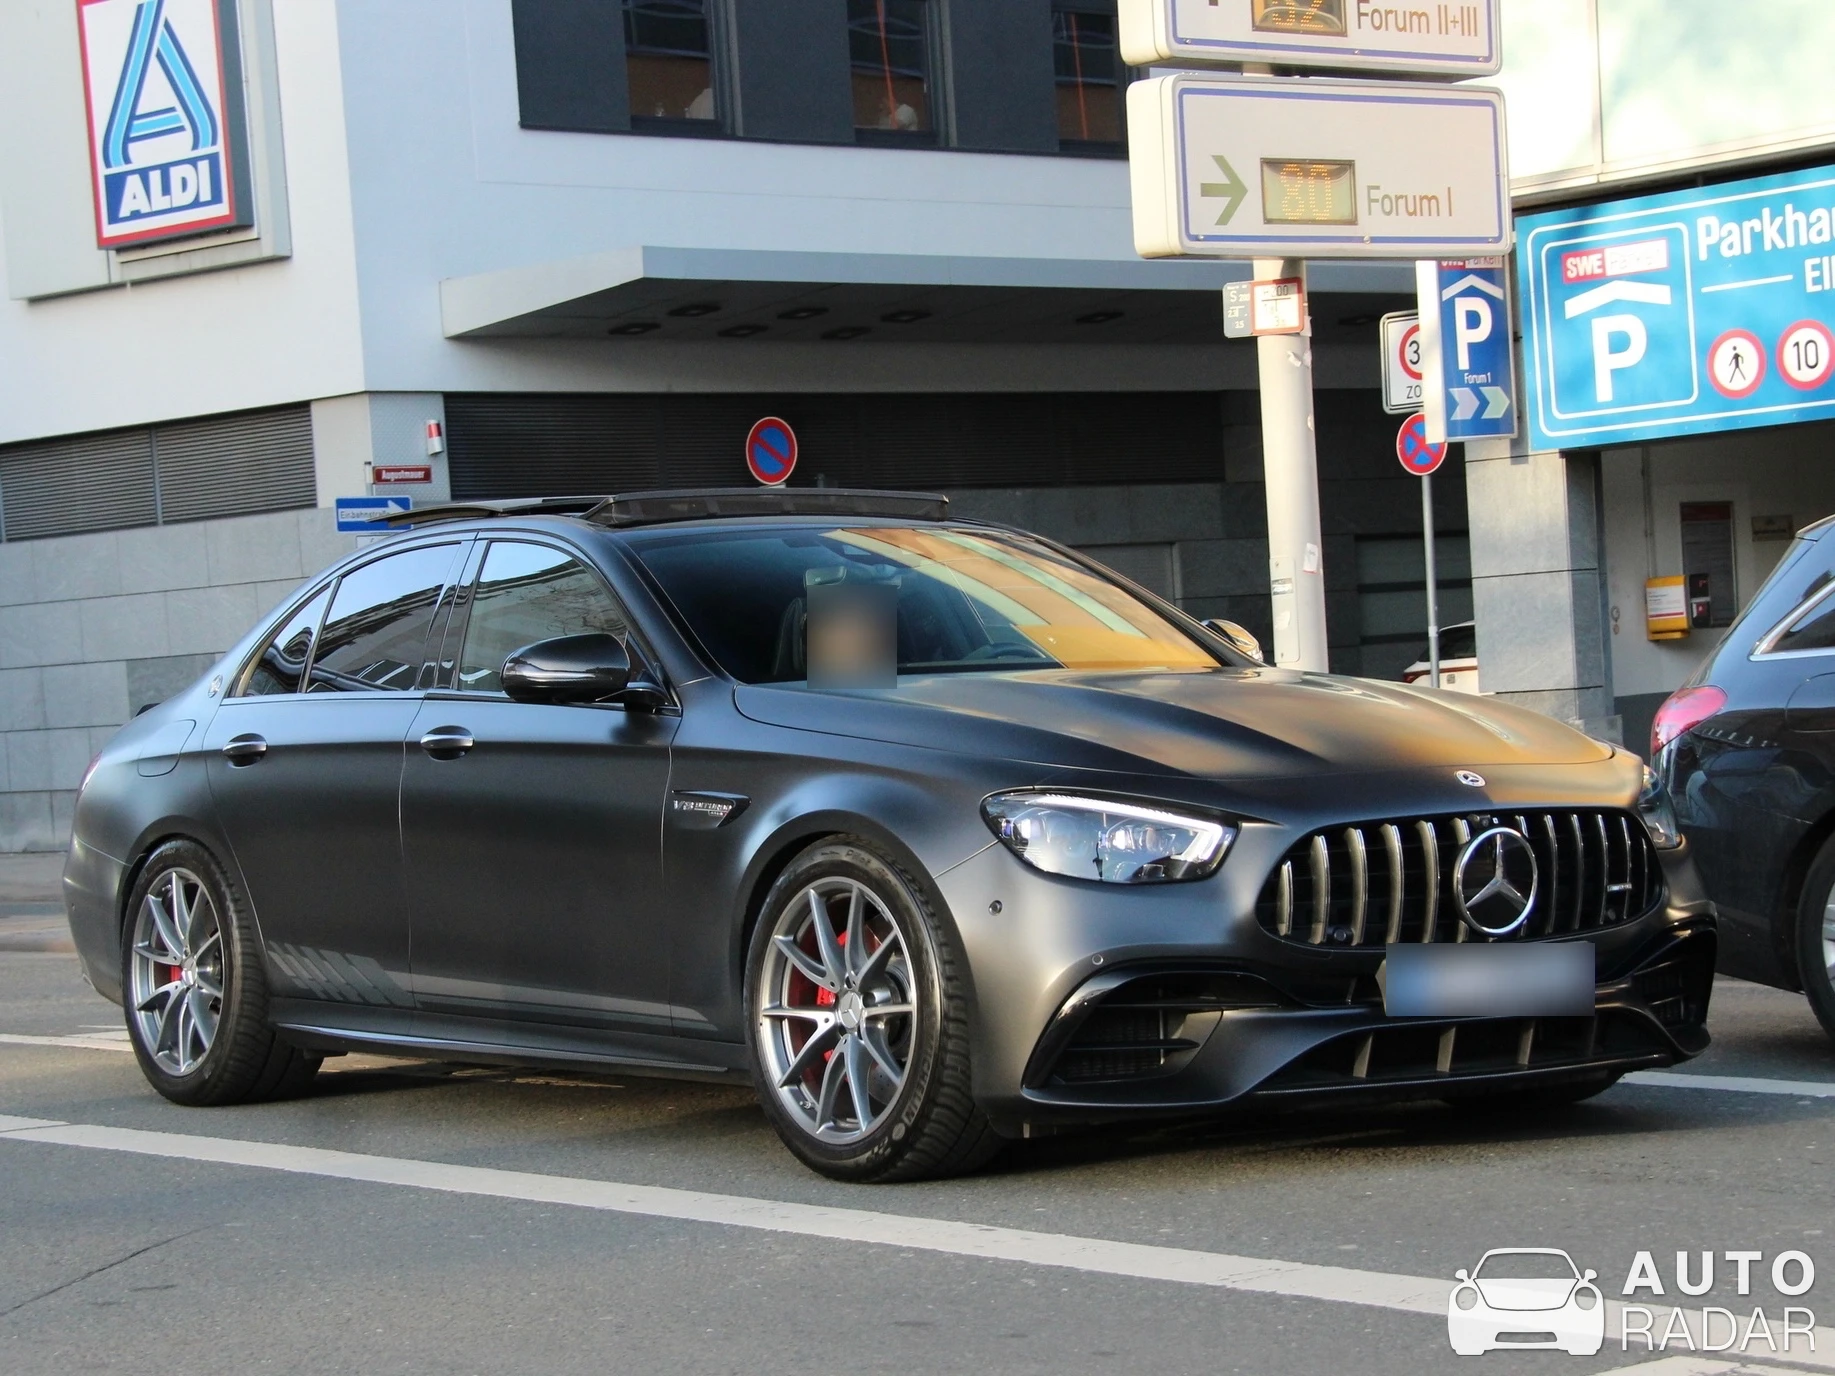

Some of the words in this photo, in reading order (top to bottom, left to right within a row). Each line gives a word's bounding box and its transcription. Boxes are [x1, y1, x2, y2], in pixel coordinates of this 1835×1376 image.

[1356, 0, 1430, 34] Forum
[118, 159, 213, 219] ALDI
[1280, 163, 1332, 220] 80
[1366, 185, 1440, 217] Forum
[1696, 203, 1835, 261] Parkha
[1565, 252, 1604, 279] SWE
[1804, 254, 1835, 293] EI
[1454, 296, 1493, 370] P
[1590, 314, 1648, 402] P
[1792, 339, 1820, 371] 10
[1464, 373, 1486, 384] Forum
